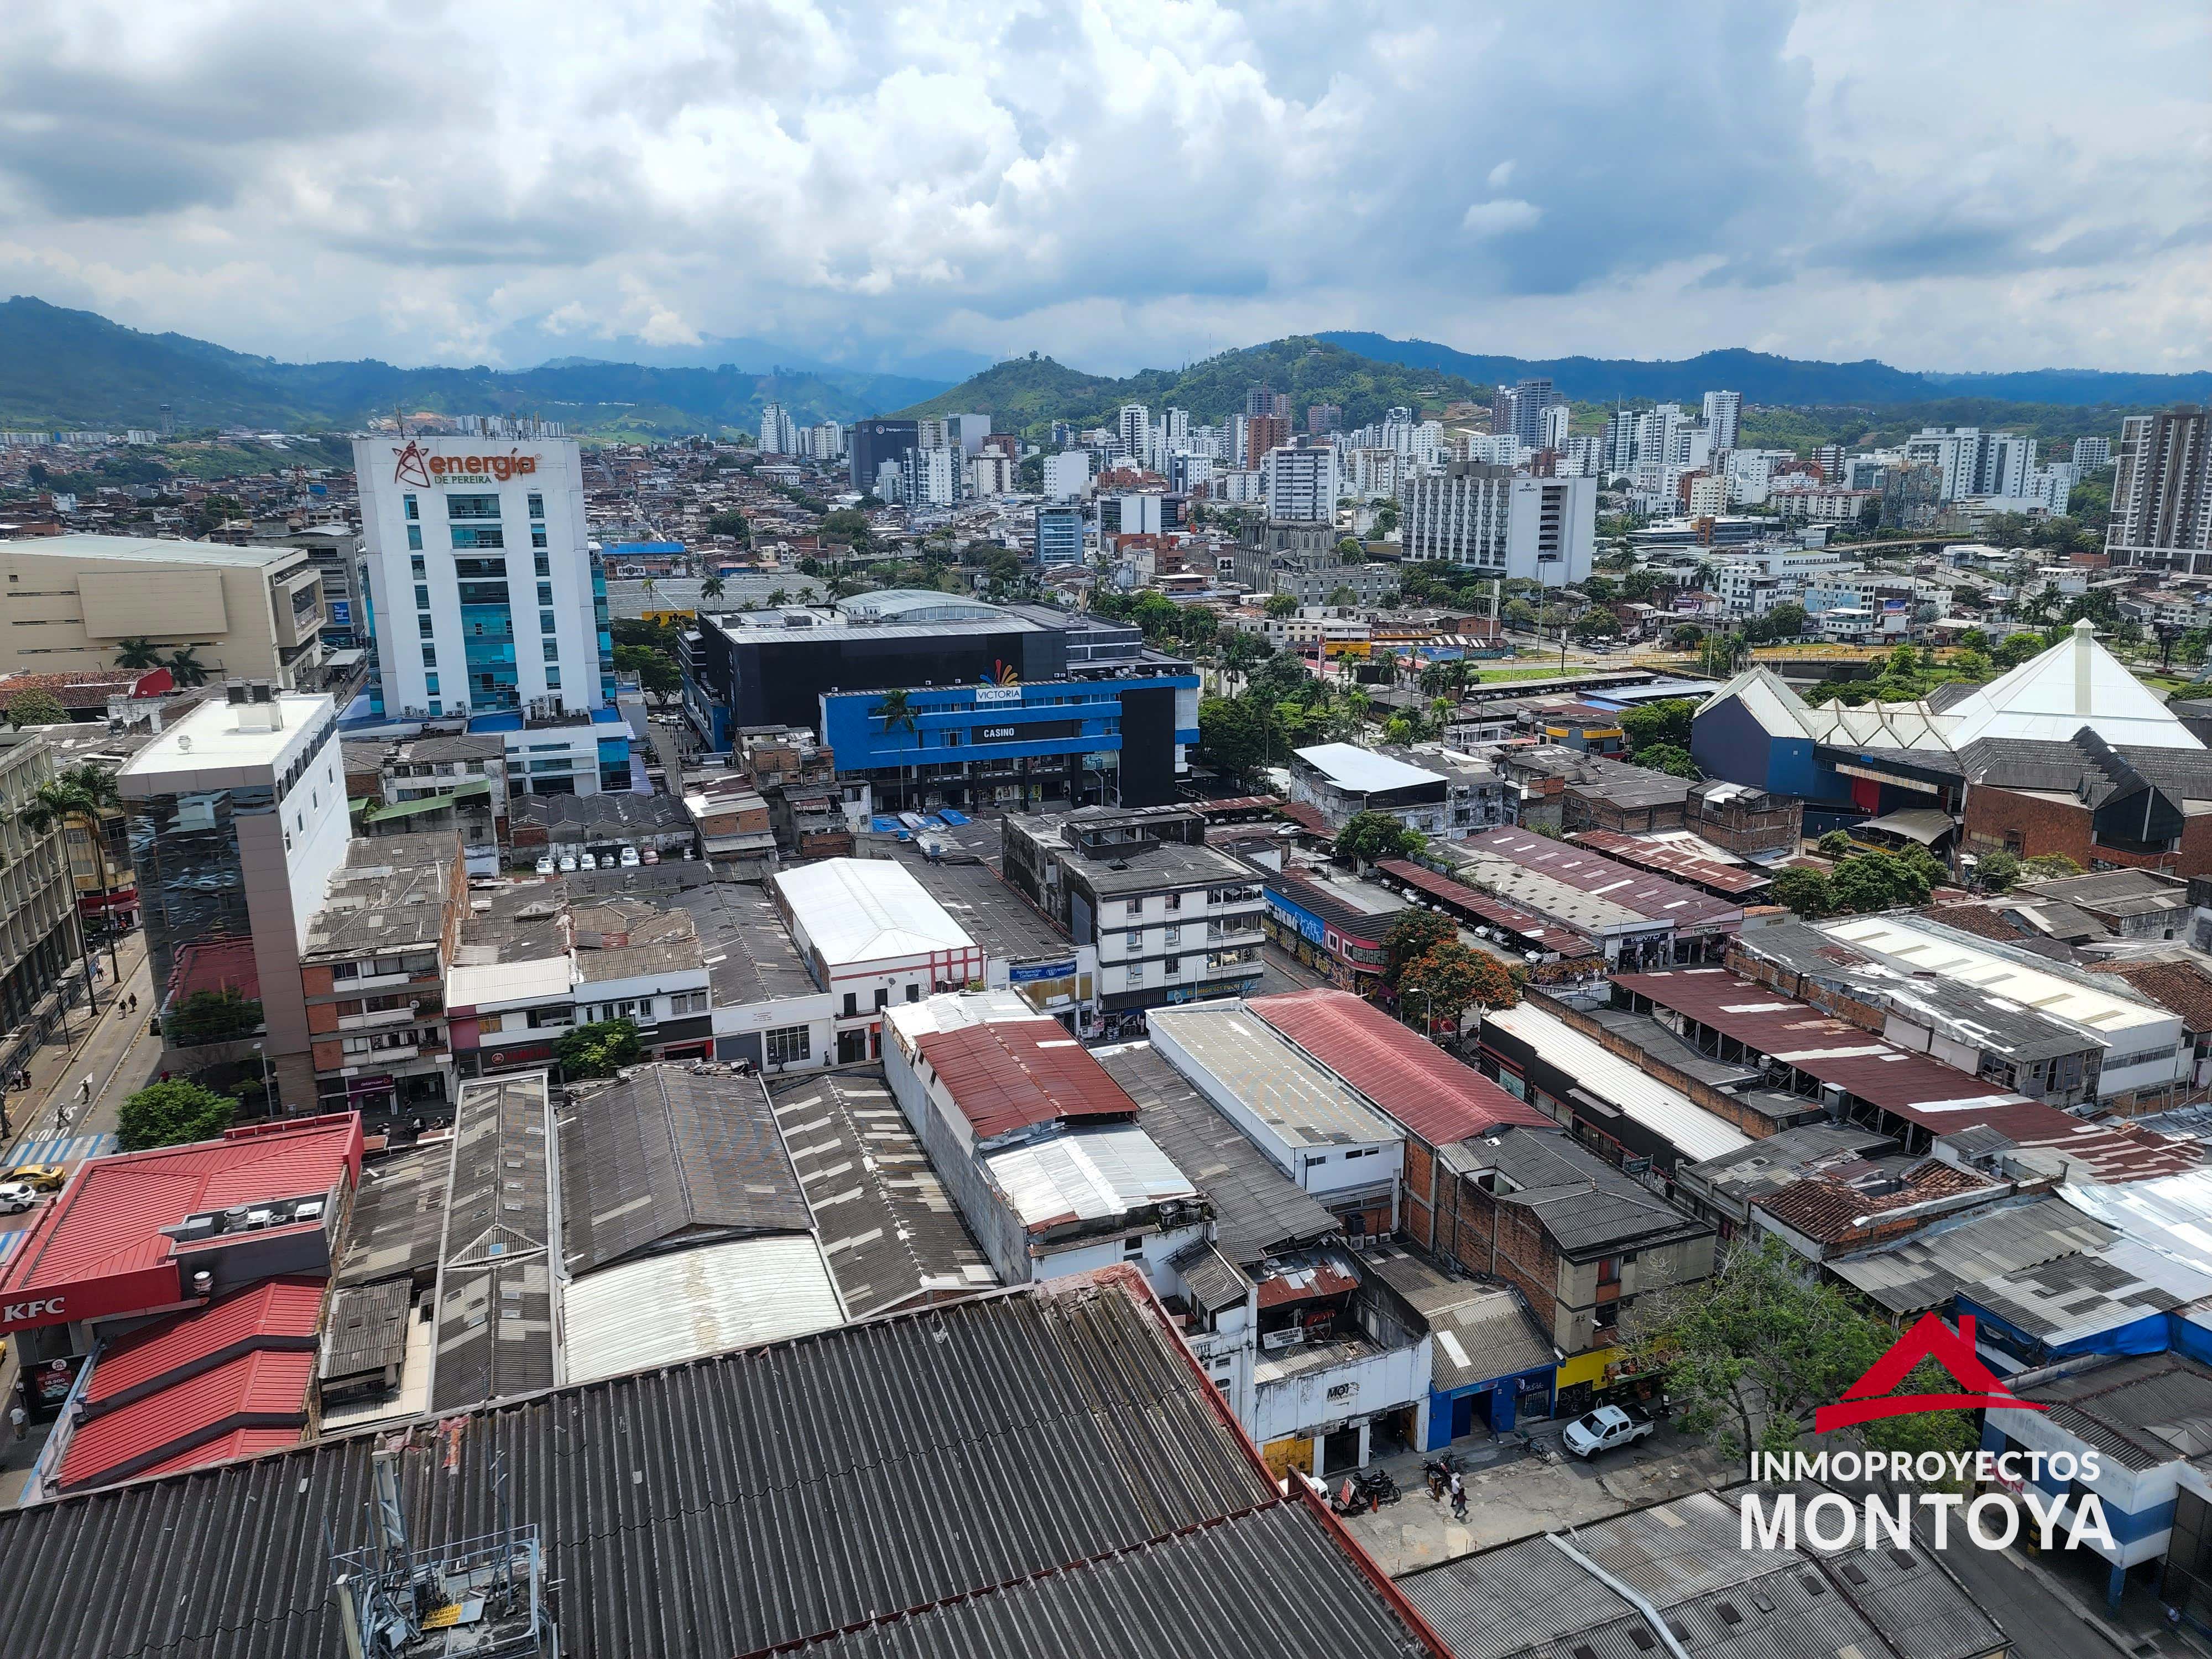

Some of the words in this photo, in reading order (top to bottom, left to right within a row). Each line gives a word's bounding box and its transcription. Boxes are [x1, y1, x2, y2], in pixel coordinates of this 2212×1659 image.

[429, 447, 535, 481] energía
[435, 476, 448, 484] DE
[452, 476, 492, 484] PEREIRA
[978, 690, 1020, 699] VICTORIA
[984, 728, 1014, 738] CASINO
[1631, 933, 1660, 942] VENTO
[2, 1297, 65, 1323] KFC
